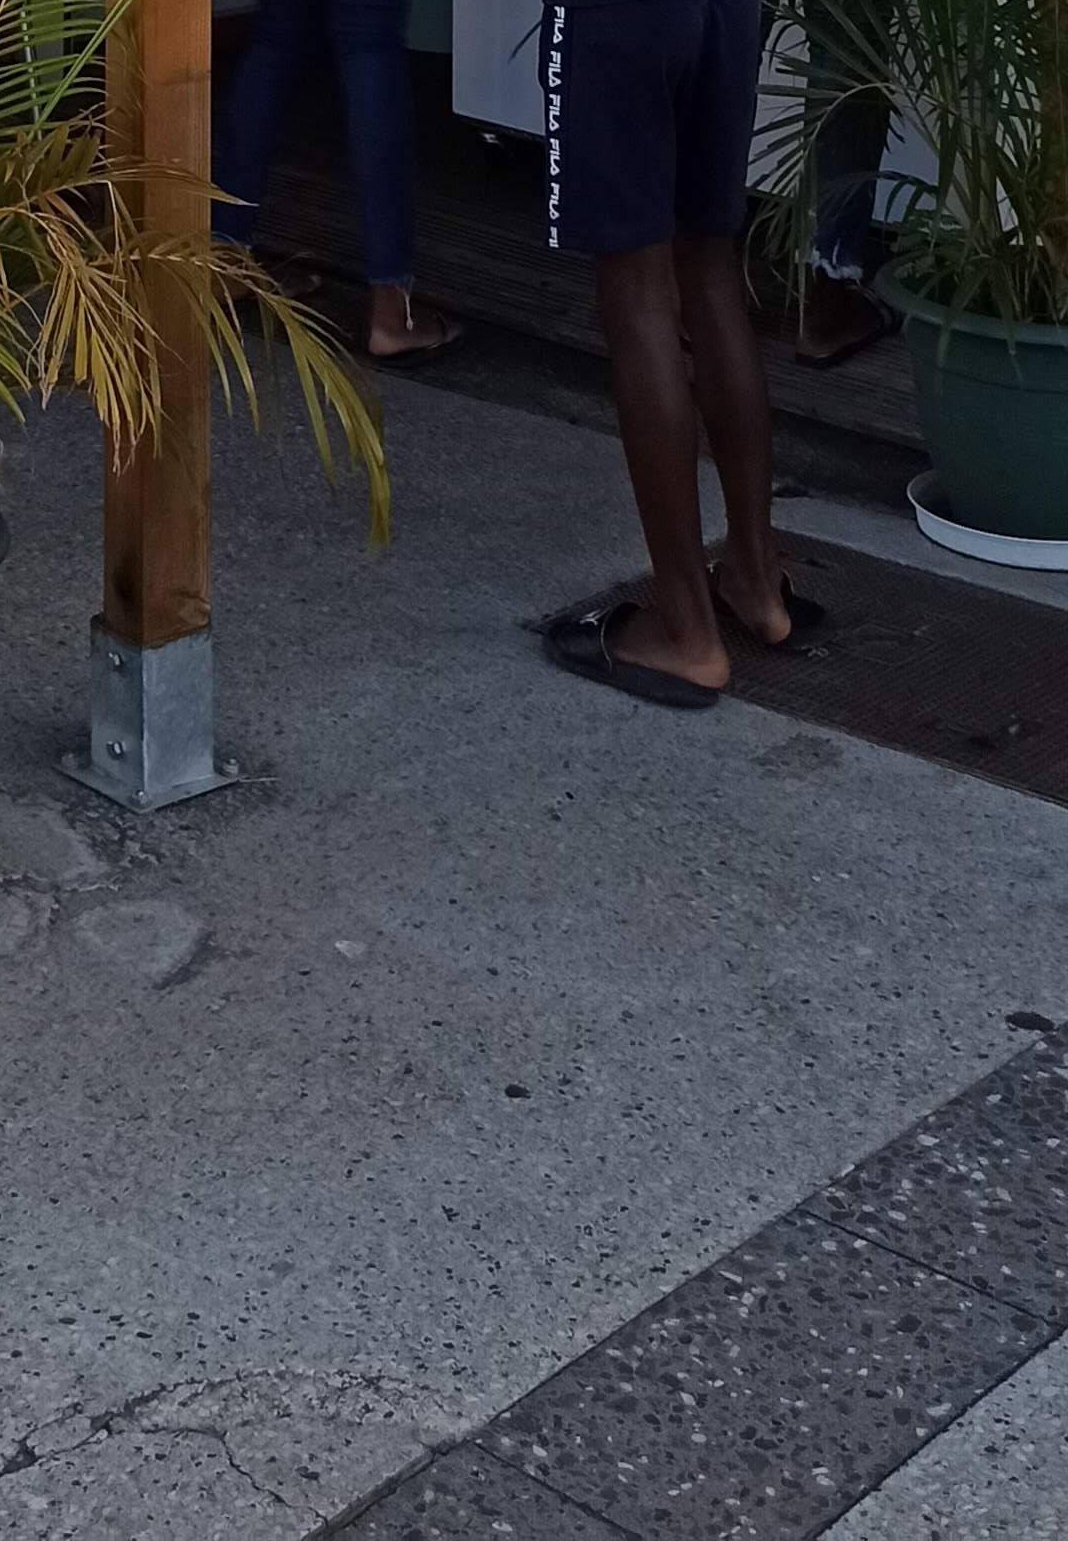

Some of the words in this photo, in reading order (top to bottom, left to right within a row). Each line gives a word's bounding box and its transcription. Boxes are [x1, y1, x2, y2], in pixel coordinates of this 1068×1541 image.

[551, 4, 566, 46] FILA
[547, 49, 563, 89] FILA
[547, 93, 562, 133] FILA
[547, 137, 562, 177] FILA
[548, 181, 562, 221] FILA
